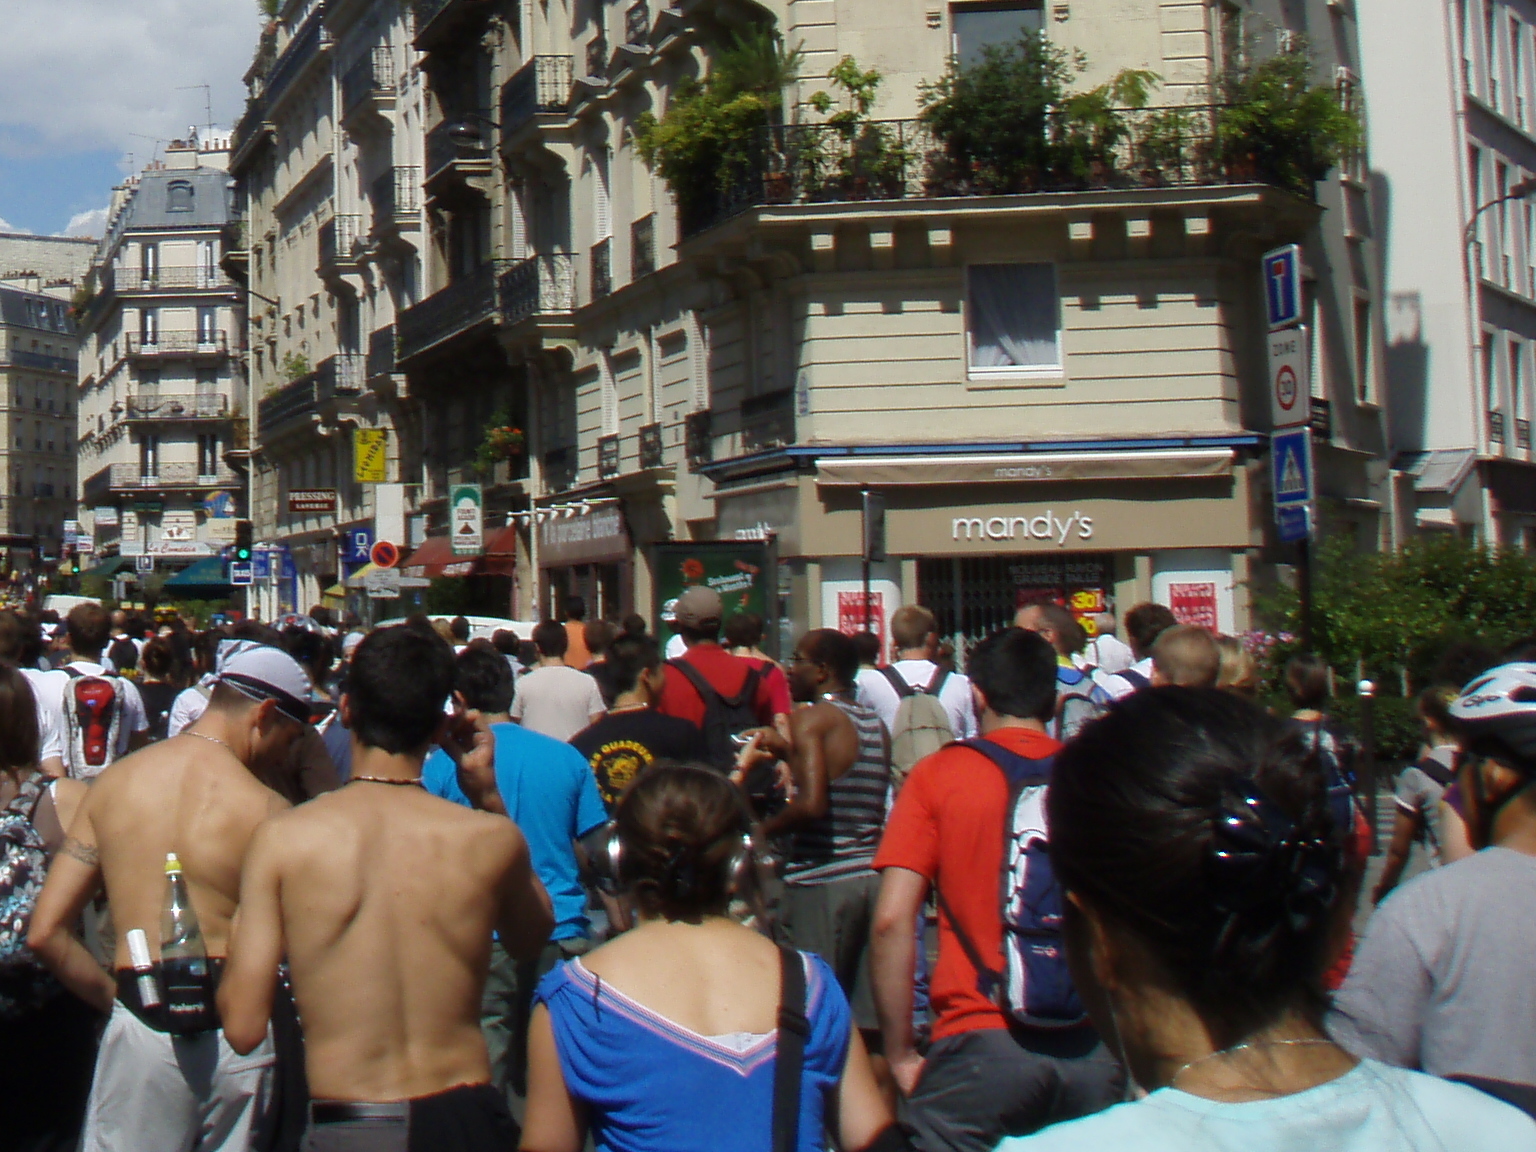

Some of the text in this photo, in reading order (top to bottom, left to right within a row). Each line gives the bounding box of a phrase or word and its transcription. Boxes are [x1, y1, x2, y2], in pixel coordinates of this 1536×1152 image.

[1272, 339, 1296, 356] ZONE
[1280, 379, 1294, 396] 30
[994, 465, 1052, 479] mandy's
[289, 491, 335, 501] PRESSING
[951, 509, 1094, 544] mandy's
